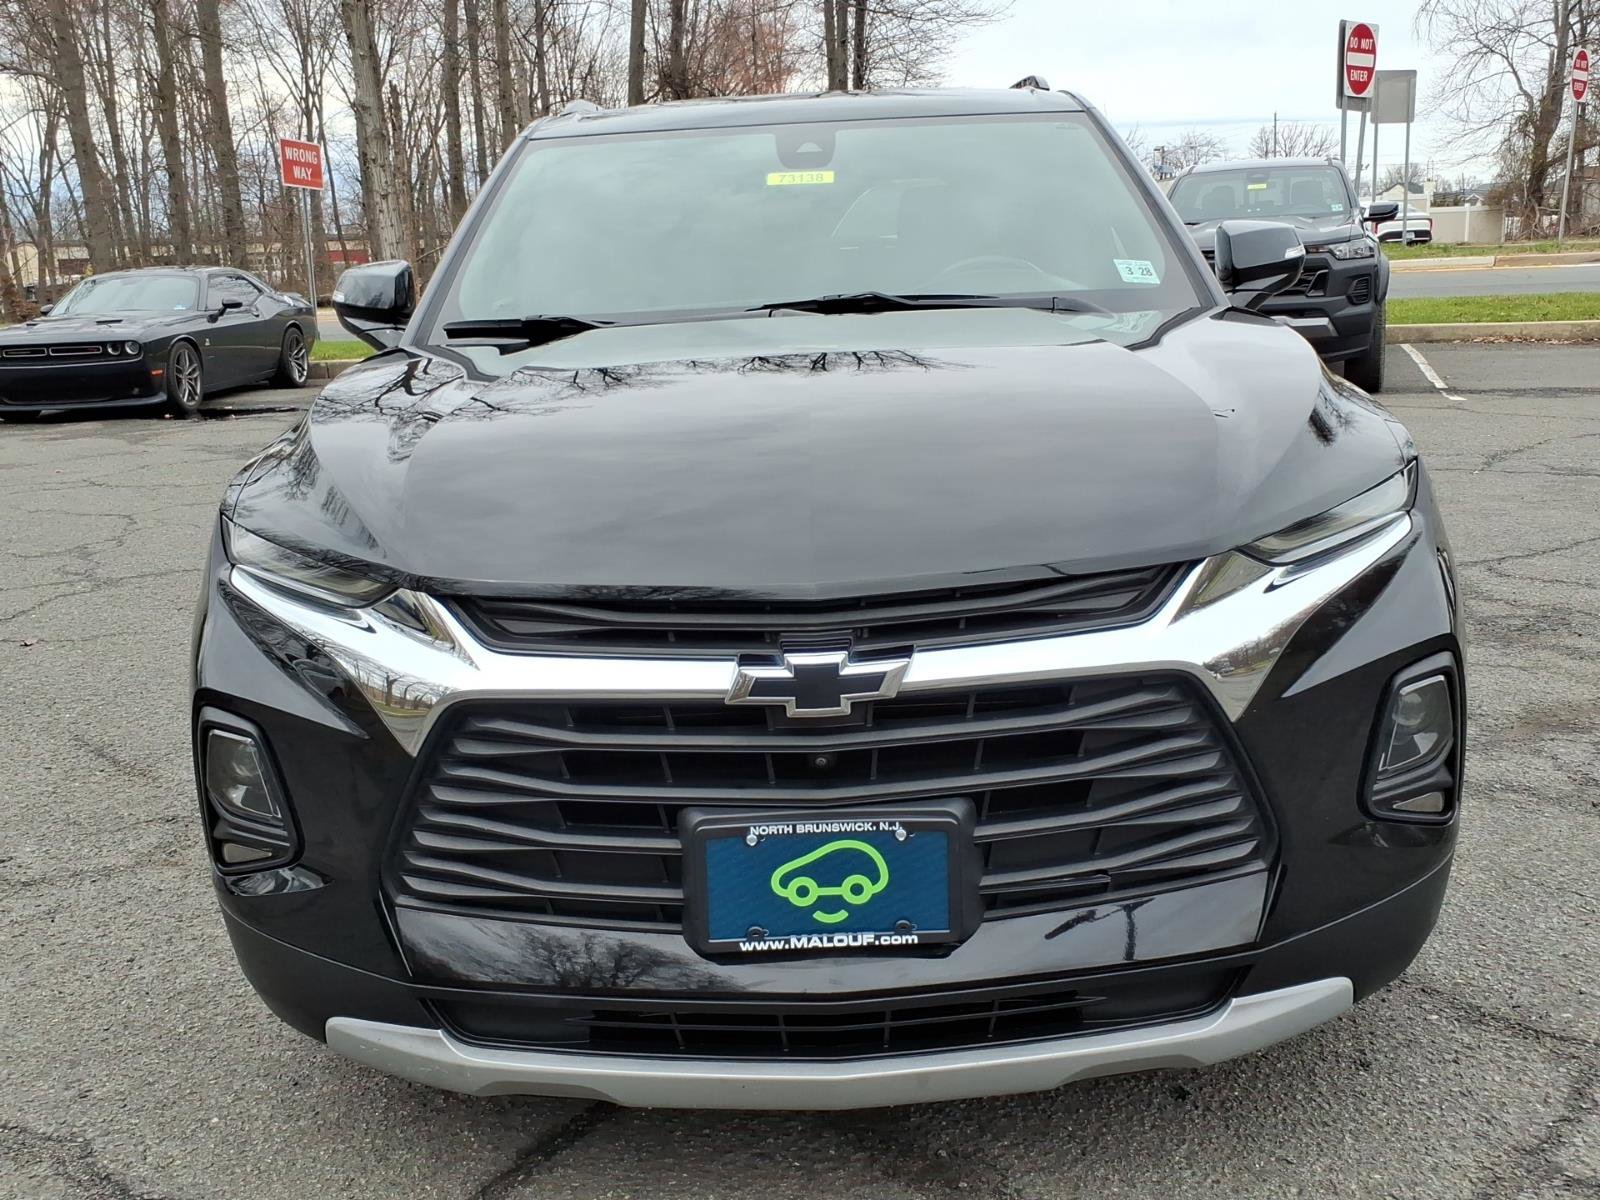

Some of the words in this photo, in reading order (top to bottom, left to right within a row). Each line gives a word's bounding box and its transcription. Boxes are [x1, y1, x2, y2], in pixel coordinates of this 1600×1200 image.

[1350, 37, 1358, 48] DO
[1361, 38, 1373, 50] NOT
[1350, 69, 1368, 81] ENTER
[284, 146, 318, 165] WRONG
[293, 165, 312, 181] WAY
[779, 173, 824, 183] 73138
[1125, 266, 1134, 275] 3
[1138, 267, 1152, 276] 28
[750, 824, 792, 836] NORTH
[879, 822, 903, 831] N.J.
[739, 932, 918, 951] www.MALOUF.com
